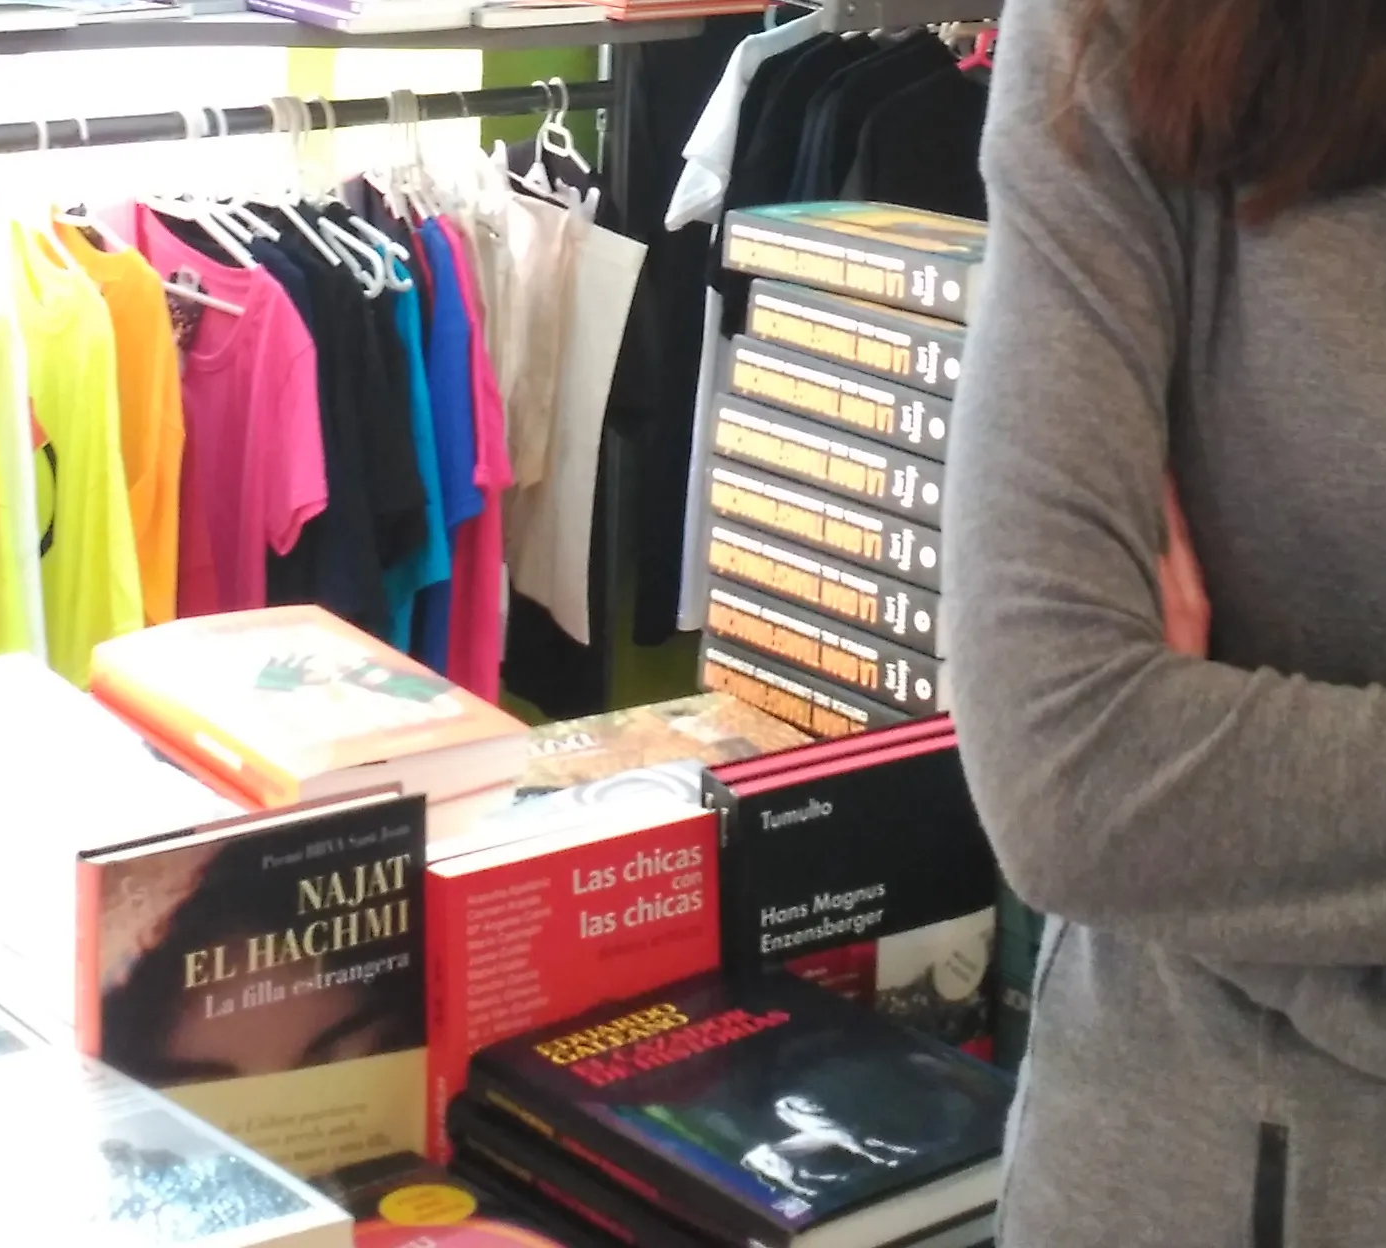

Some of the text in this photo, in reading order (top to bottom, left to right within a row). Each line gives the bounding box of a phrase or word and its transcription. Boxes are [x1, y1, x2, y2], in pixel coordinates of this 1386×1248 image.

[760, 797, 834, 830] Tumulto
[296, 853, 412, 916] NAJAT
[572, 845, 703, 895] Las chicas
[671, 871, 704, 890] con
[579, 890, 703, 939] las chicas
[760, 883, 886, 927] Hans Magnus
[184, 899, 409, 989] EL HACHMI
[760, 909, 885, 955] Enzensberger
[204, 952, 410, 1019] La filla estrangera
